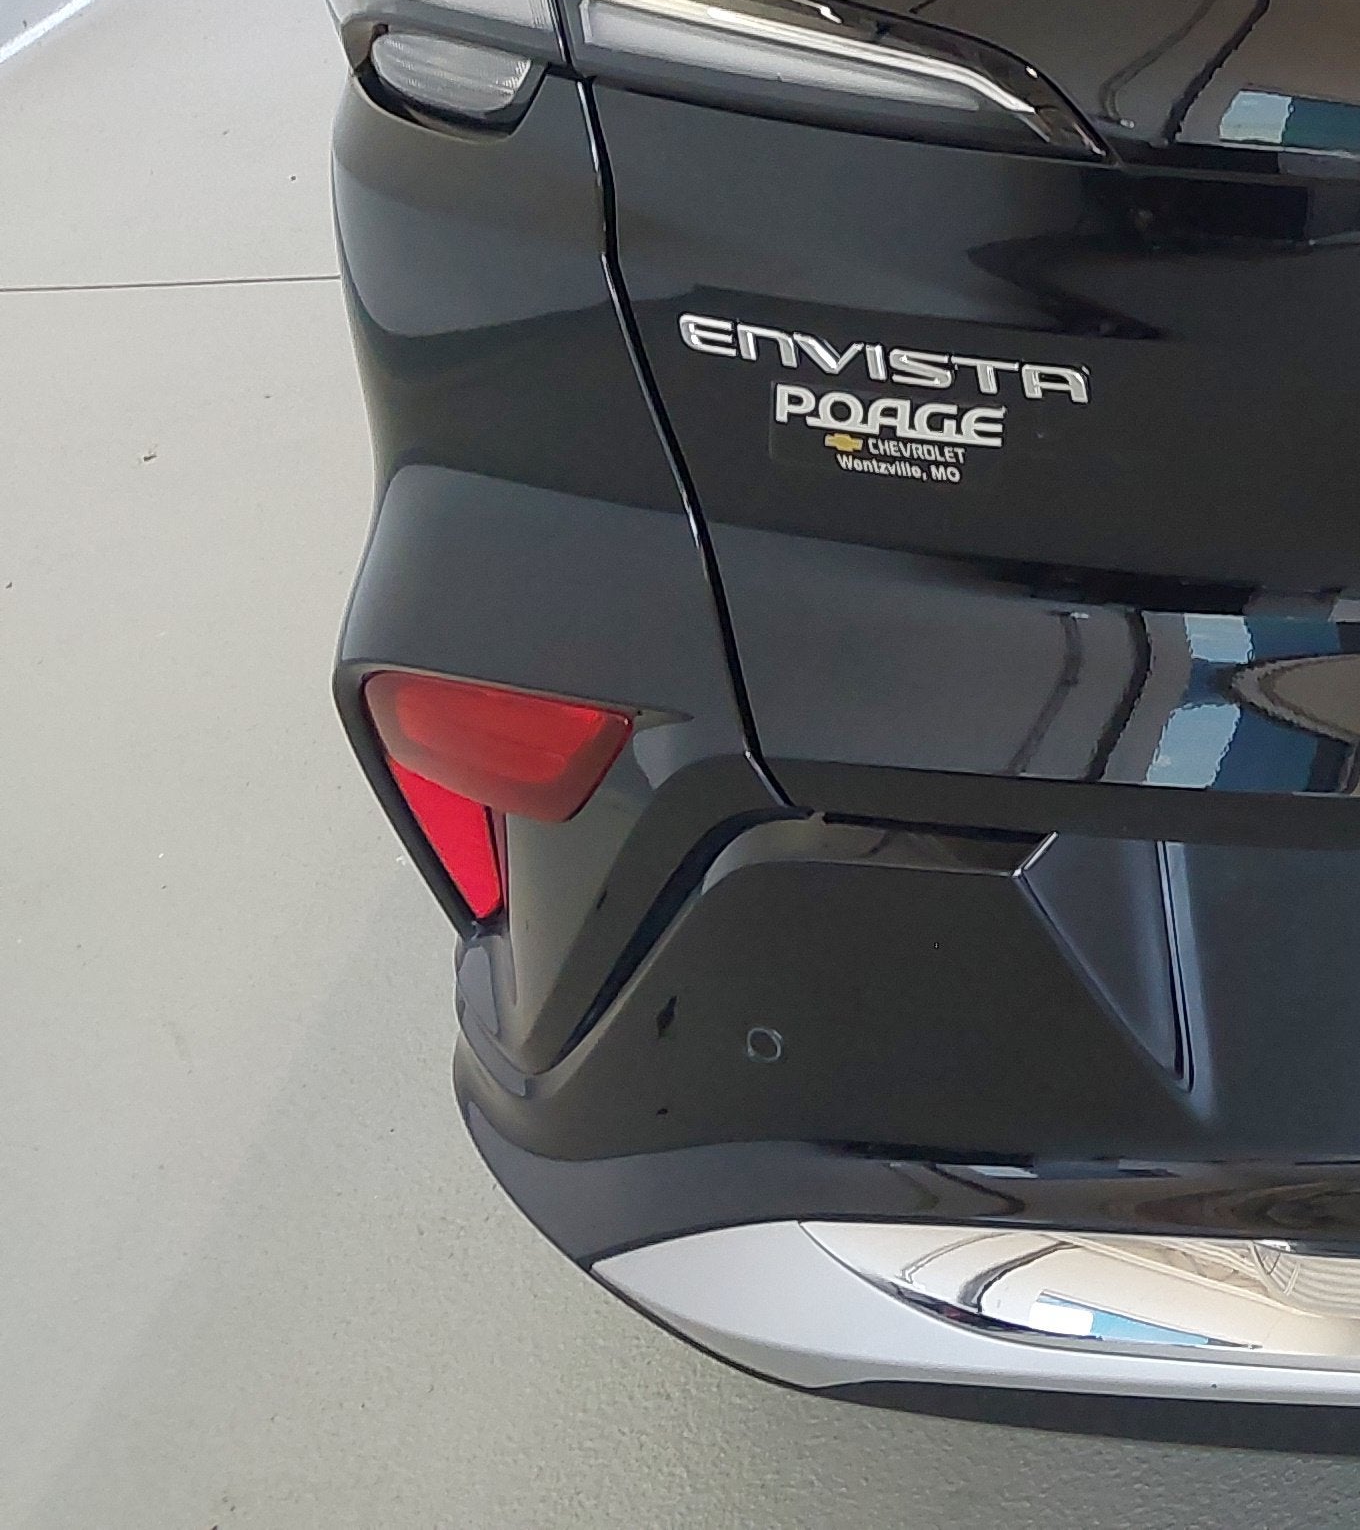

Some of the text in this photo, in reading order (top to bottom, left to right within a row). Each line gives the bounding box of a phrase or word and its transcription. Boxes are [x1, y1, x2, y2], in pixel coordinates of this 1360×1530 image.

[678, 312, 1091, 404] ENVISTA
[774, 383, 1006, 447] POAGE
[867, 437, 966, 464] CHEVROLET
[929, 464, 961, 483] MO
